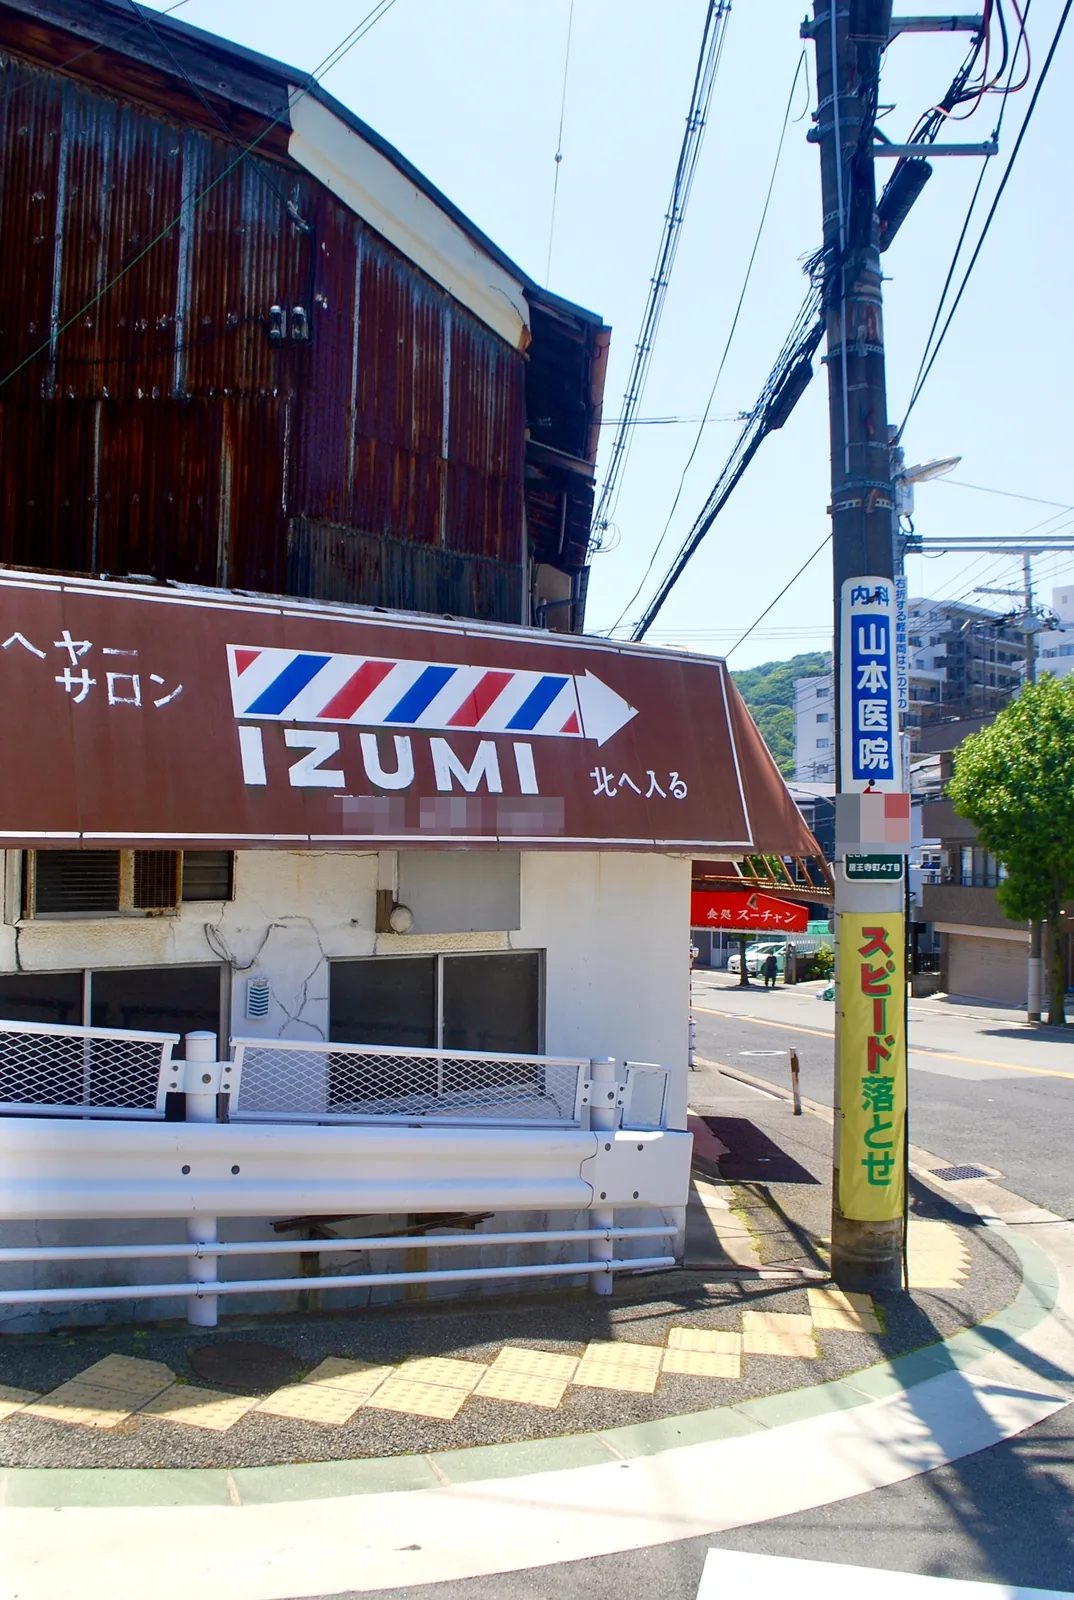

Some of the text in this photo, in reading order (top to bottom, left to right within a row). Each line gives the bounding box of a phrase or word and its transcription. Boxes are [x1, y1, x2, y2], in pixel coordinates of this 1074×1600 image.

[851, 585, 889, 607] 内科
[1, 630, 138, 666] ヘヤー
[895, 578, 907, 709] 右折する軽車両はこの下の
[55, 667, 183, 708] サロン
[856, 623, 890, 770] 山本医院
[238, 725, 539, 795] IZUMI
[590, 766, 688, 800] 北へ入る
[736, 910, 798, 924] スーチャン
[857, 926, 896, 1187] スピード落とせ
